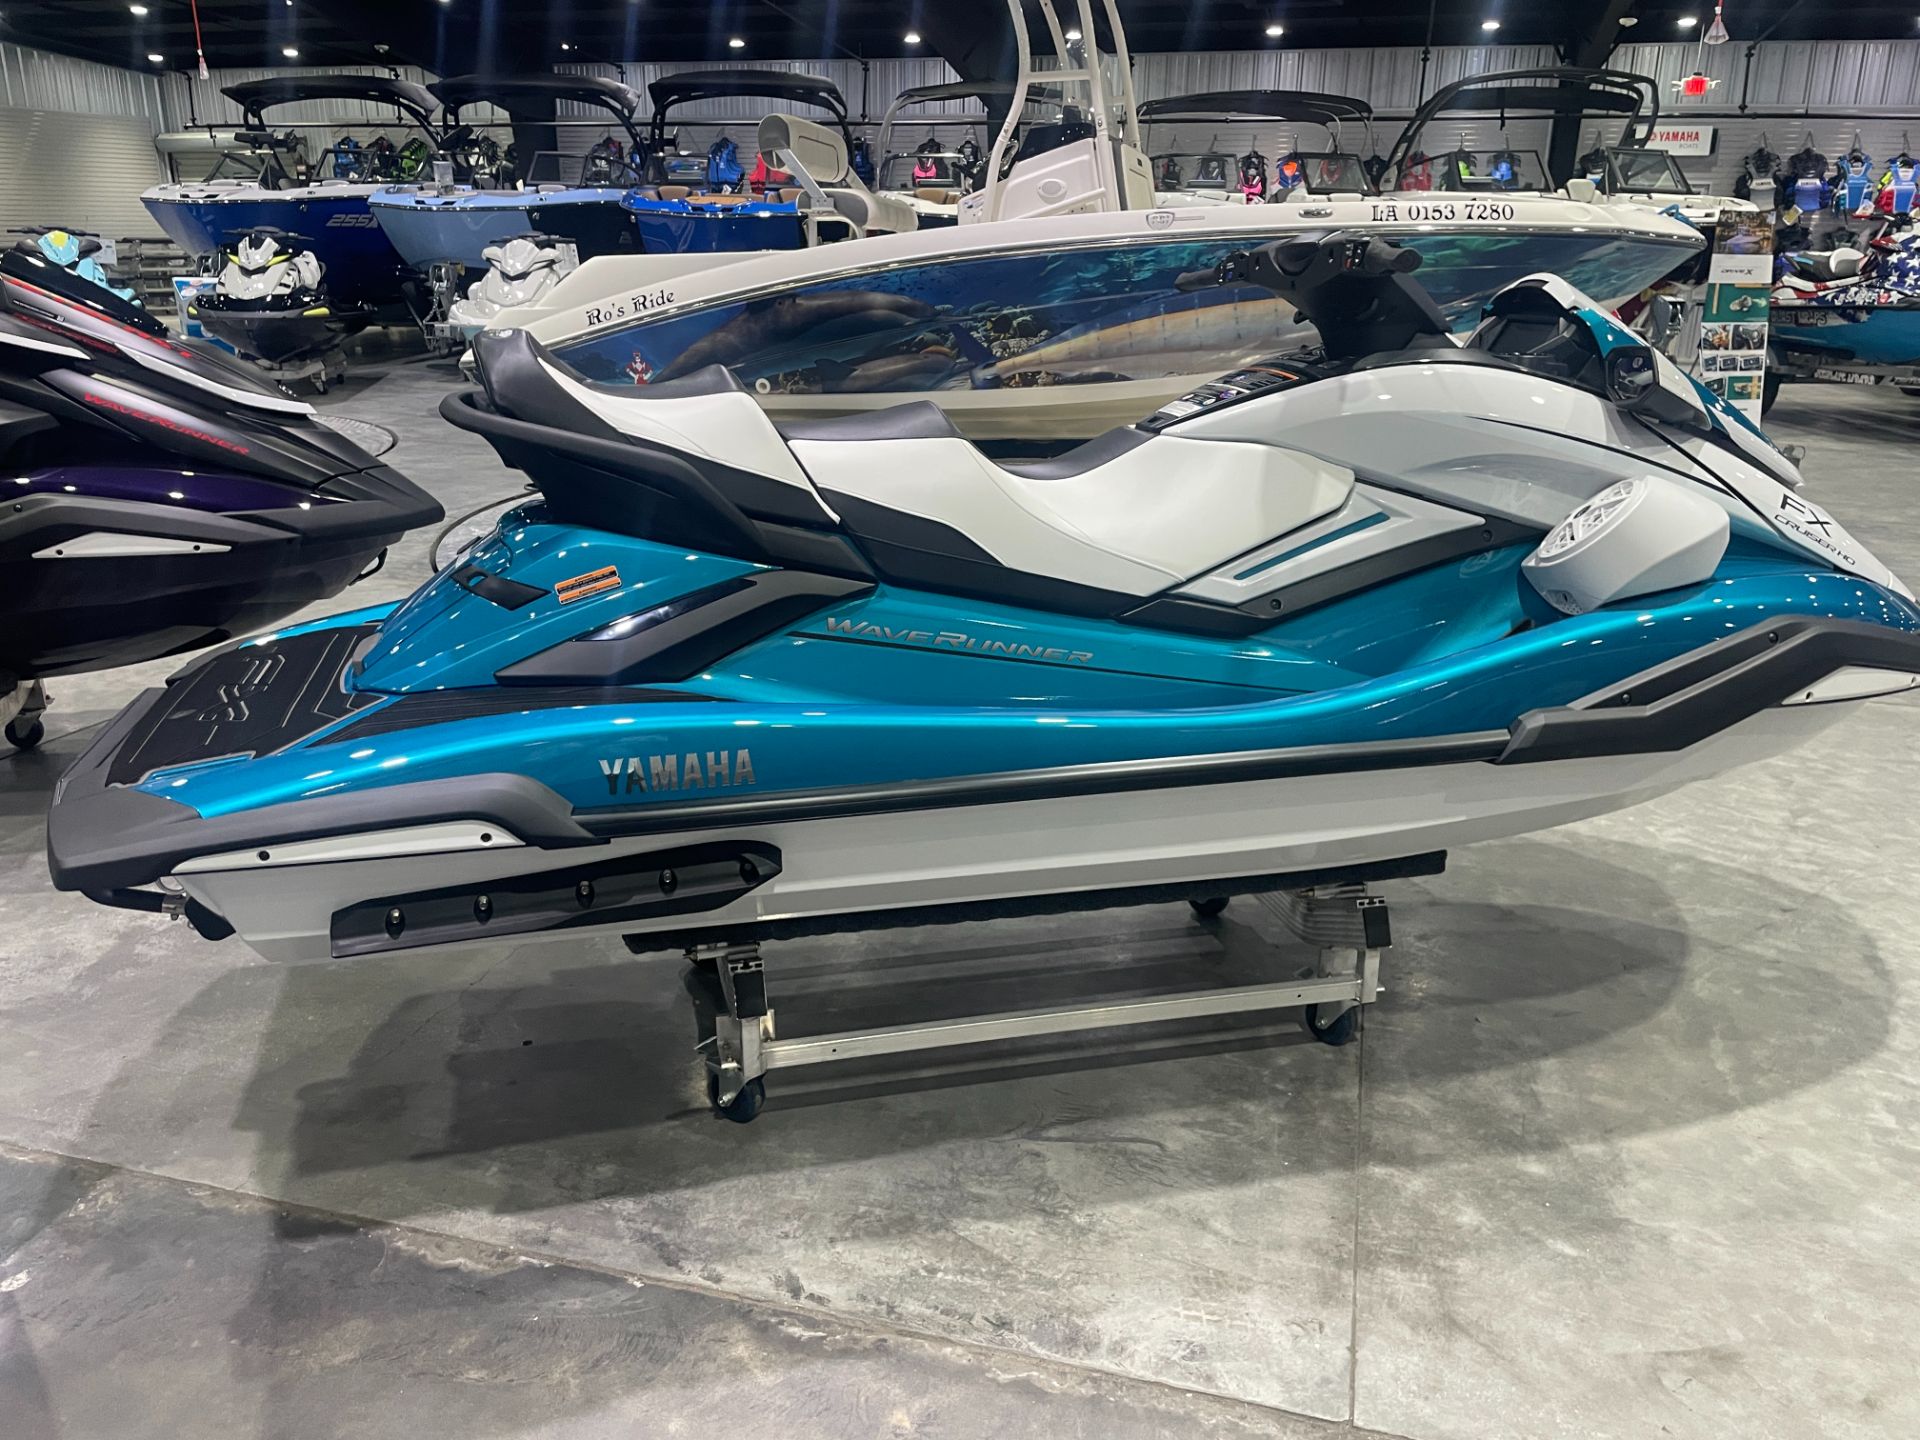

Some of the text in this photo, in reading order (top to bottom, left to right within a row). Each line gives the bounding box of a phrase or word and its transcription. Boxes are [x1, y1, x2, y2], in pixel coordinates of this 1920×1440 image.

[1659, 131, 1700, 142] YAMAHA
[1371, 203, 1515, 222] LA 0153 7280
[585, 289, 675, 327] Ro's Ride
[1774, 514, 1837, 553] CRUISER
[1780, 493, 1833, 539] FX
[598, 748, 757, 796] YAMAHA
